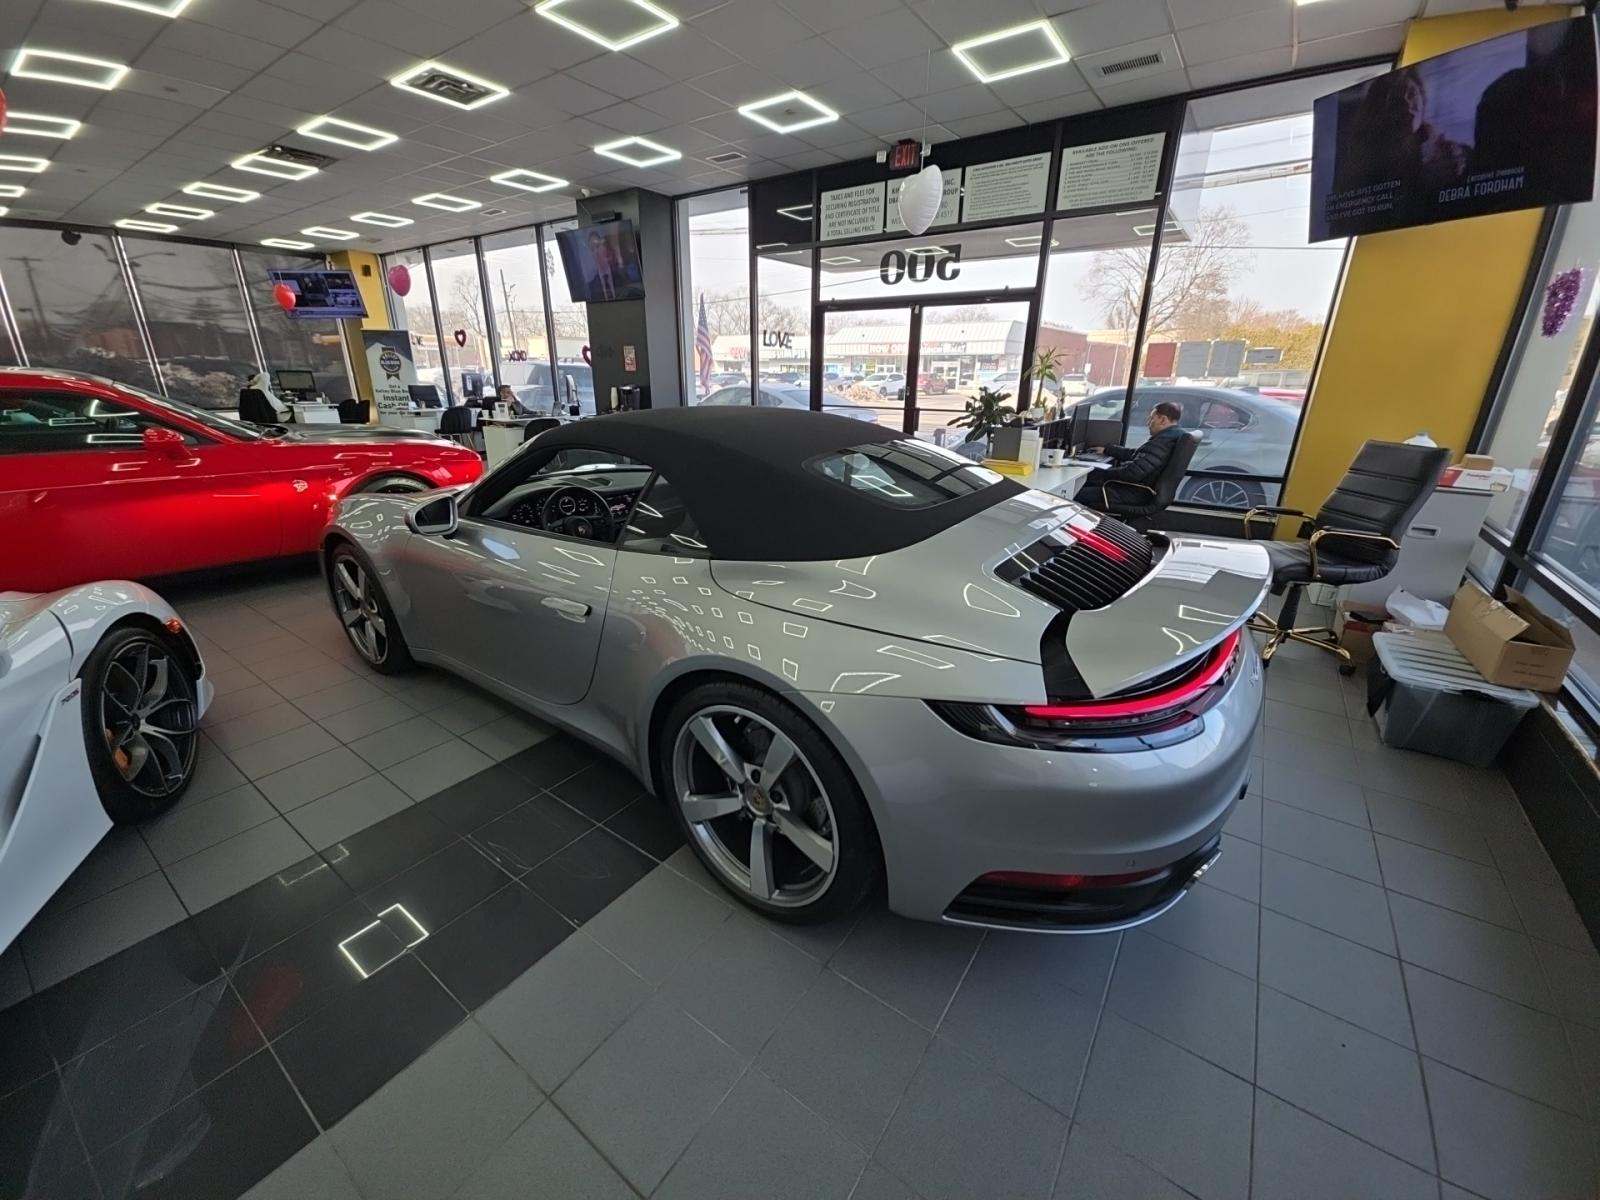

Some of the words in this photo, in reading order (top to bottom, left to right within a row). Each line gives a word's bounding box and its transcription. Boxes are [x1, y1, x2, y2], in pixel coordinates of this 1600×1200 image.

[894, 143, 916, 167] EXIT
[1373, 179, 1401, 191] GOTTEN
[1438, 186, 1471, 203] DEBRA
[1473, 176, 1524, 197] FORDHAM
[848, 196, 880, 207] REGISTRATION
[1376, 191, 1393, 200] CALL
[835, 208, 861, 219] CERTIFICATE
[868, 205, 880, 214] TITLE
[763, 329, 795, 349] LOVE
